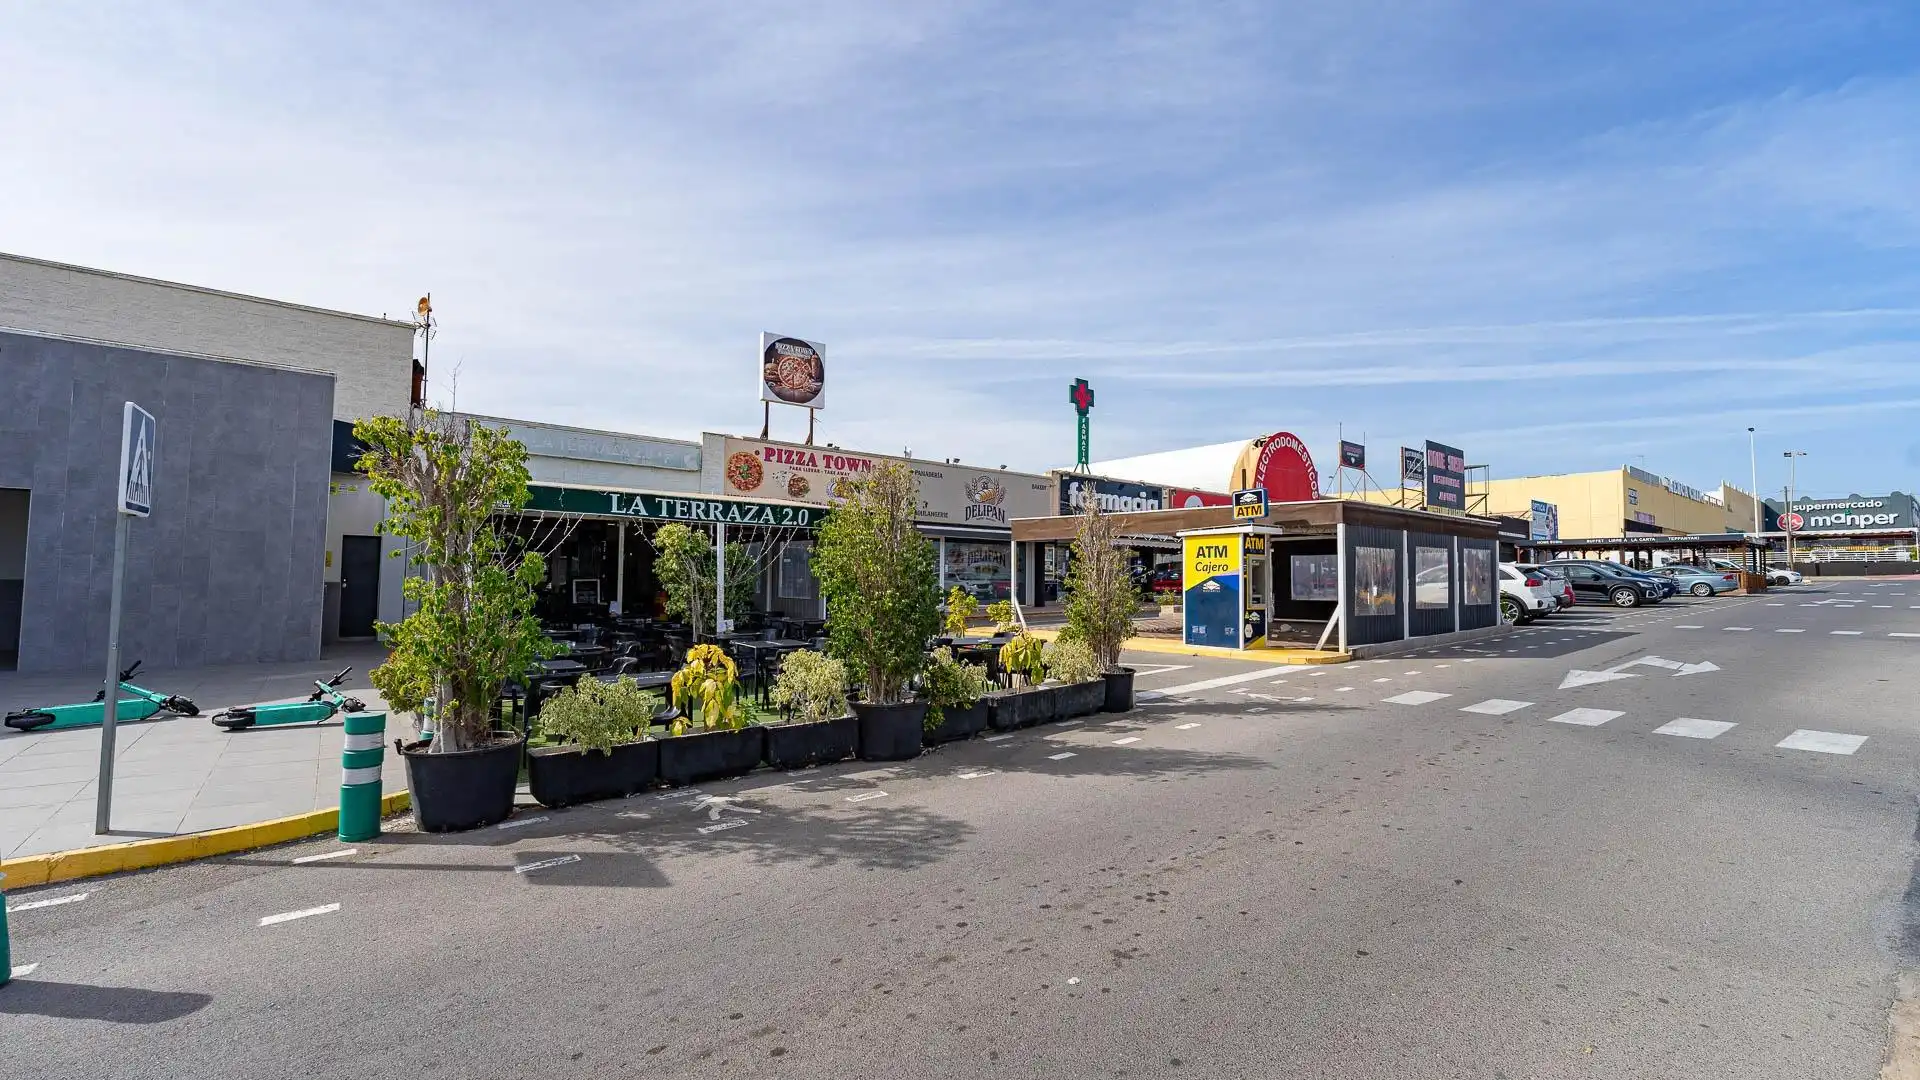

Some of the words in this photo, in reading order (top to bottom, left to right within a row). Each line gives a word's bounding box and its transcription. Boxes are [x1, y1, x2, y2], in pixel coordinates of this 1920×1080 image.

[763, 446, 818, 468] PIZZA
[823, 454, 872, 474] TOWN
[610, 493, 649, 516] LA
[655, 498, 776, 525] TERRAZA
[782, 507, 809, 526] 2.0
[1236, 505, 1262, 517] ATM
[1792, 499, 1883, 513] supermercado
[914, 509, 949, 519] OULANGERIE
[965, 504, 1006, 524] DELIPAN
[1810, 512, 1899, 528] manper
[1245, 537, 1264, 550] ATM
[1196, 545, 1228, 559] ATM
[1195, 562, 1229, 574] Cajero
